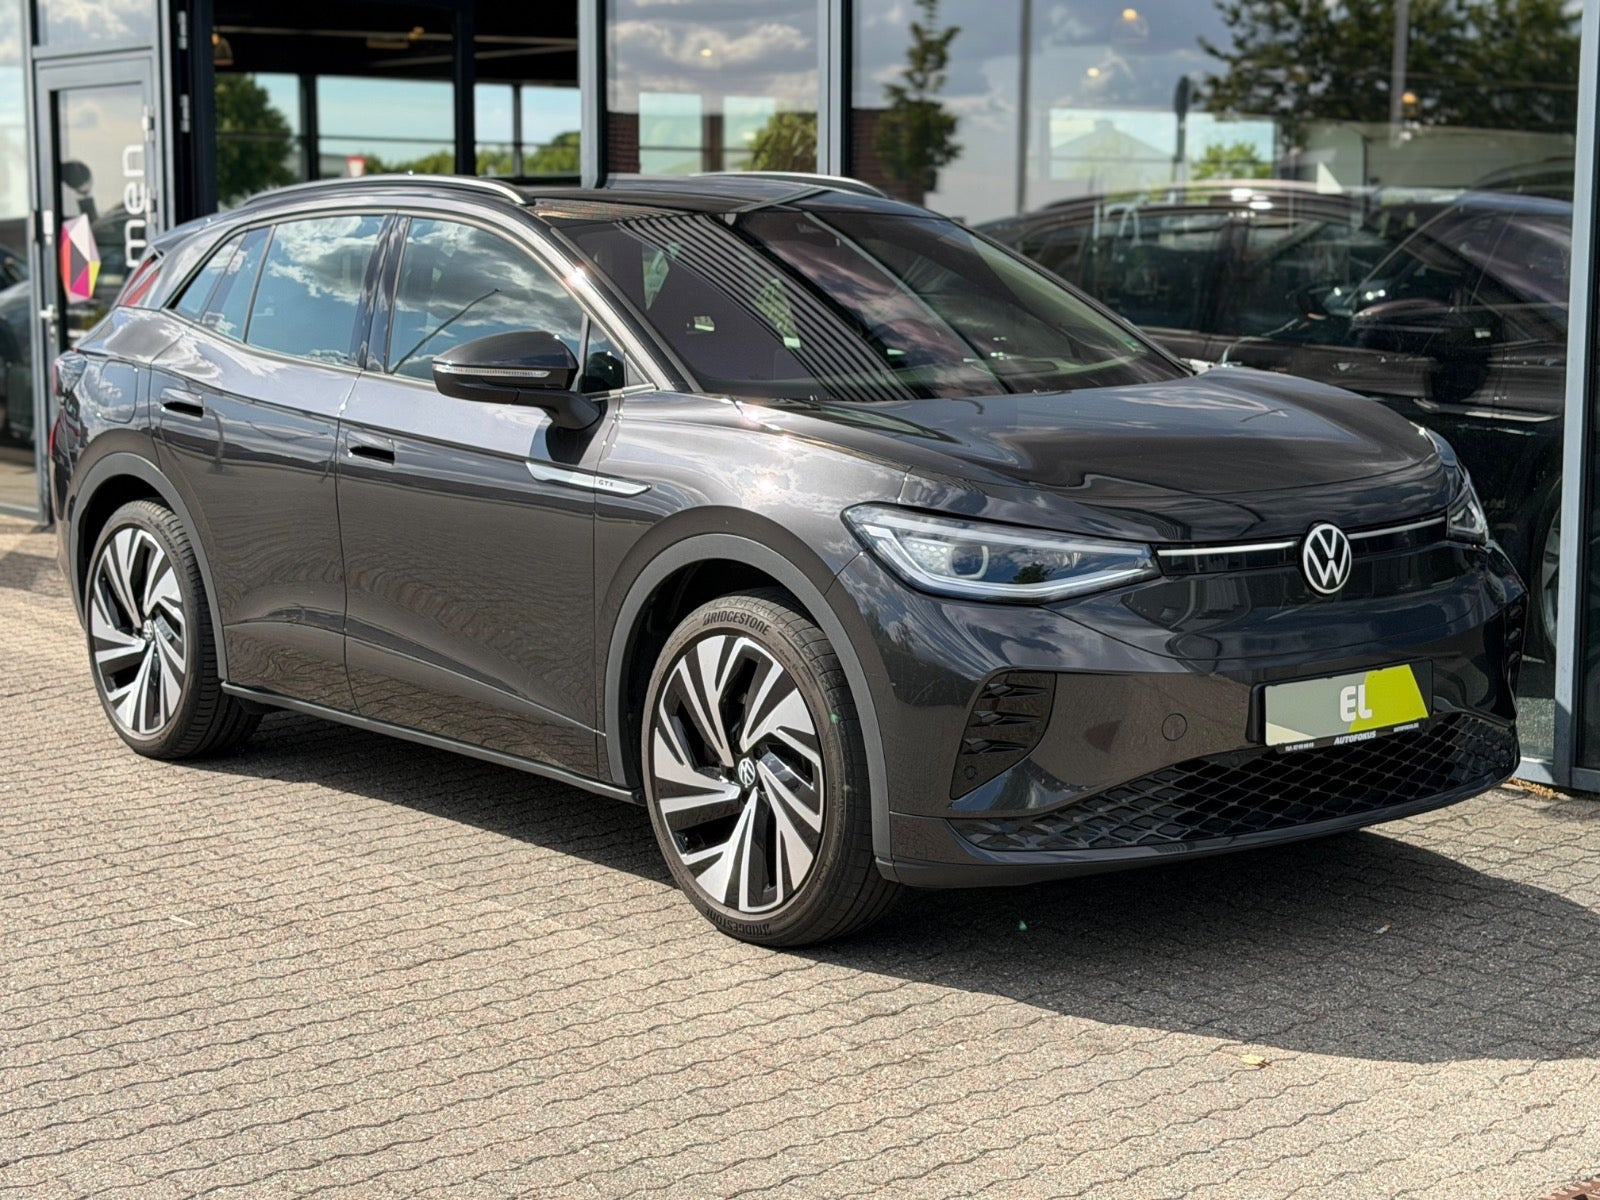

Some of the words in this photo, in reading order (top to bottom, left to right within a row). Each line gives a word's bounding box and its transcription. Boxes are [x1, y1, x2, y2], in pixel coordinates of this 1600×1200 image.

[702, 610, 771, 636] BRIDGESTONE
[1339, 684, 1373, 722] EL
[1333, 730, 1377, 746] AUTOFOKUS
[704, 907, 771, 936] BRIDGESTONE
